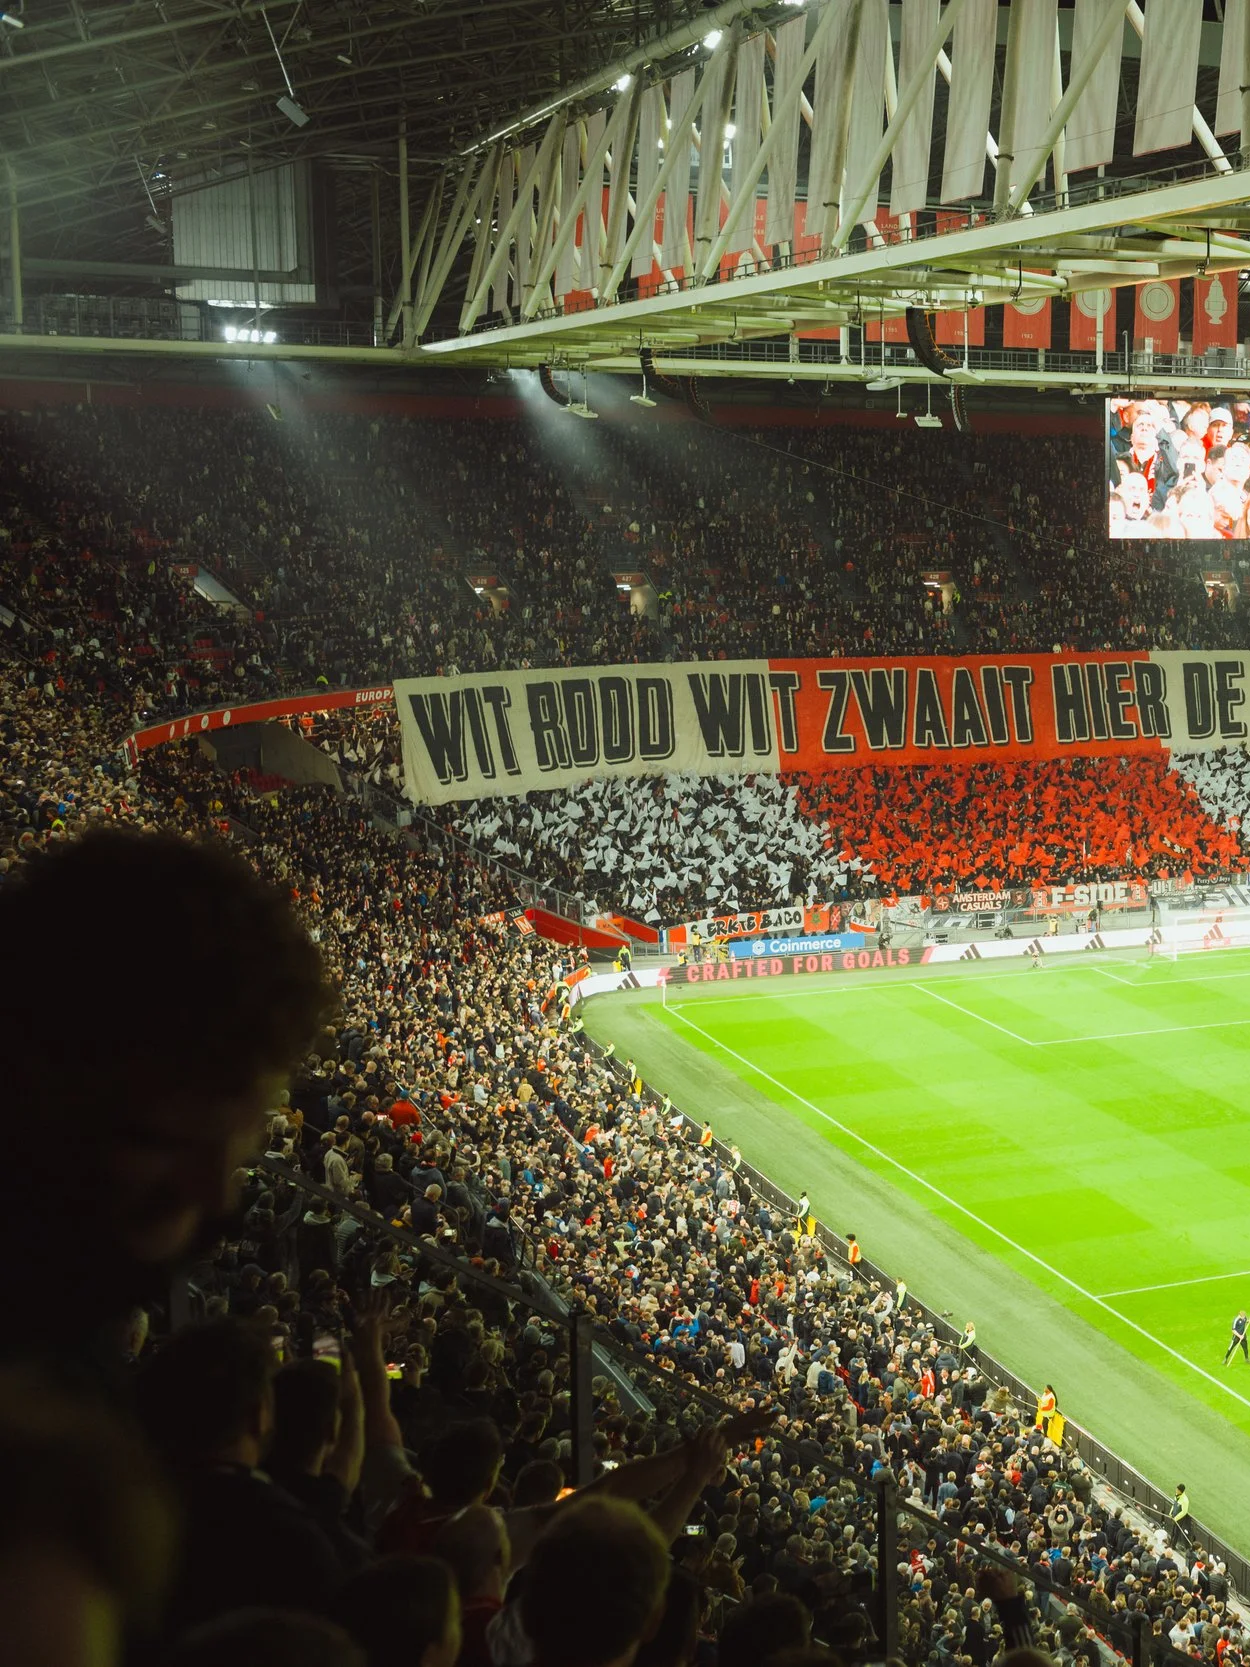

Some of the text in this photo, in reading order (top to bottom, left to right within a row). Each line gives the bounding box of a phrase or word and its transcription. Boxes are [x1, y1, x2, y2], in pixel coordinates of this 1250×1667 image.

[408, 682, 521, 785] WIT
[687, 670, 800, 757] WIT
[816, 666, 1033, 753] ZWAAIT
[1051, 660, 1172, 743] HIER
[1182, 661, 1248, 739] DE
[952, 891, 1011, 904] AMSTERDAM
[1051, 882, 1128, 908] F-SIDE
[960, 900, 1002, 912] CASUALS
[519, 918, 532, 932] M
[760, 910, 802, 930] BACO
[769, 939, 841, 953] Coinmerce
[686, 948, 910, 983] CRAFTED FOR GOALS
